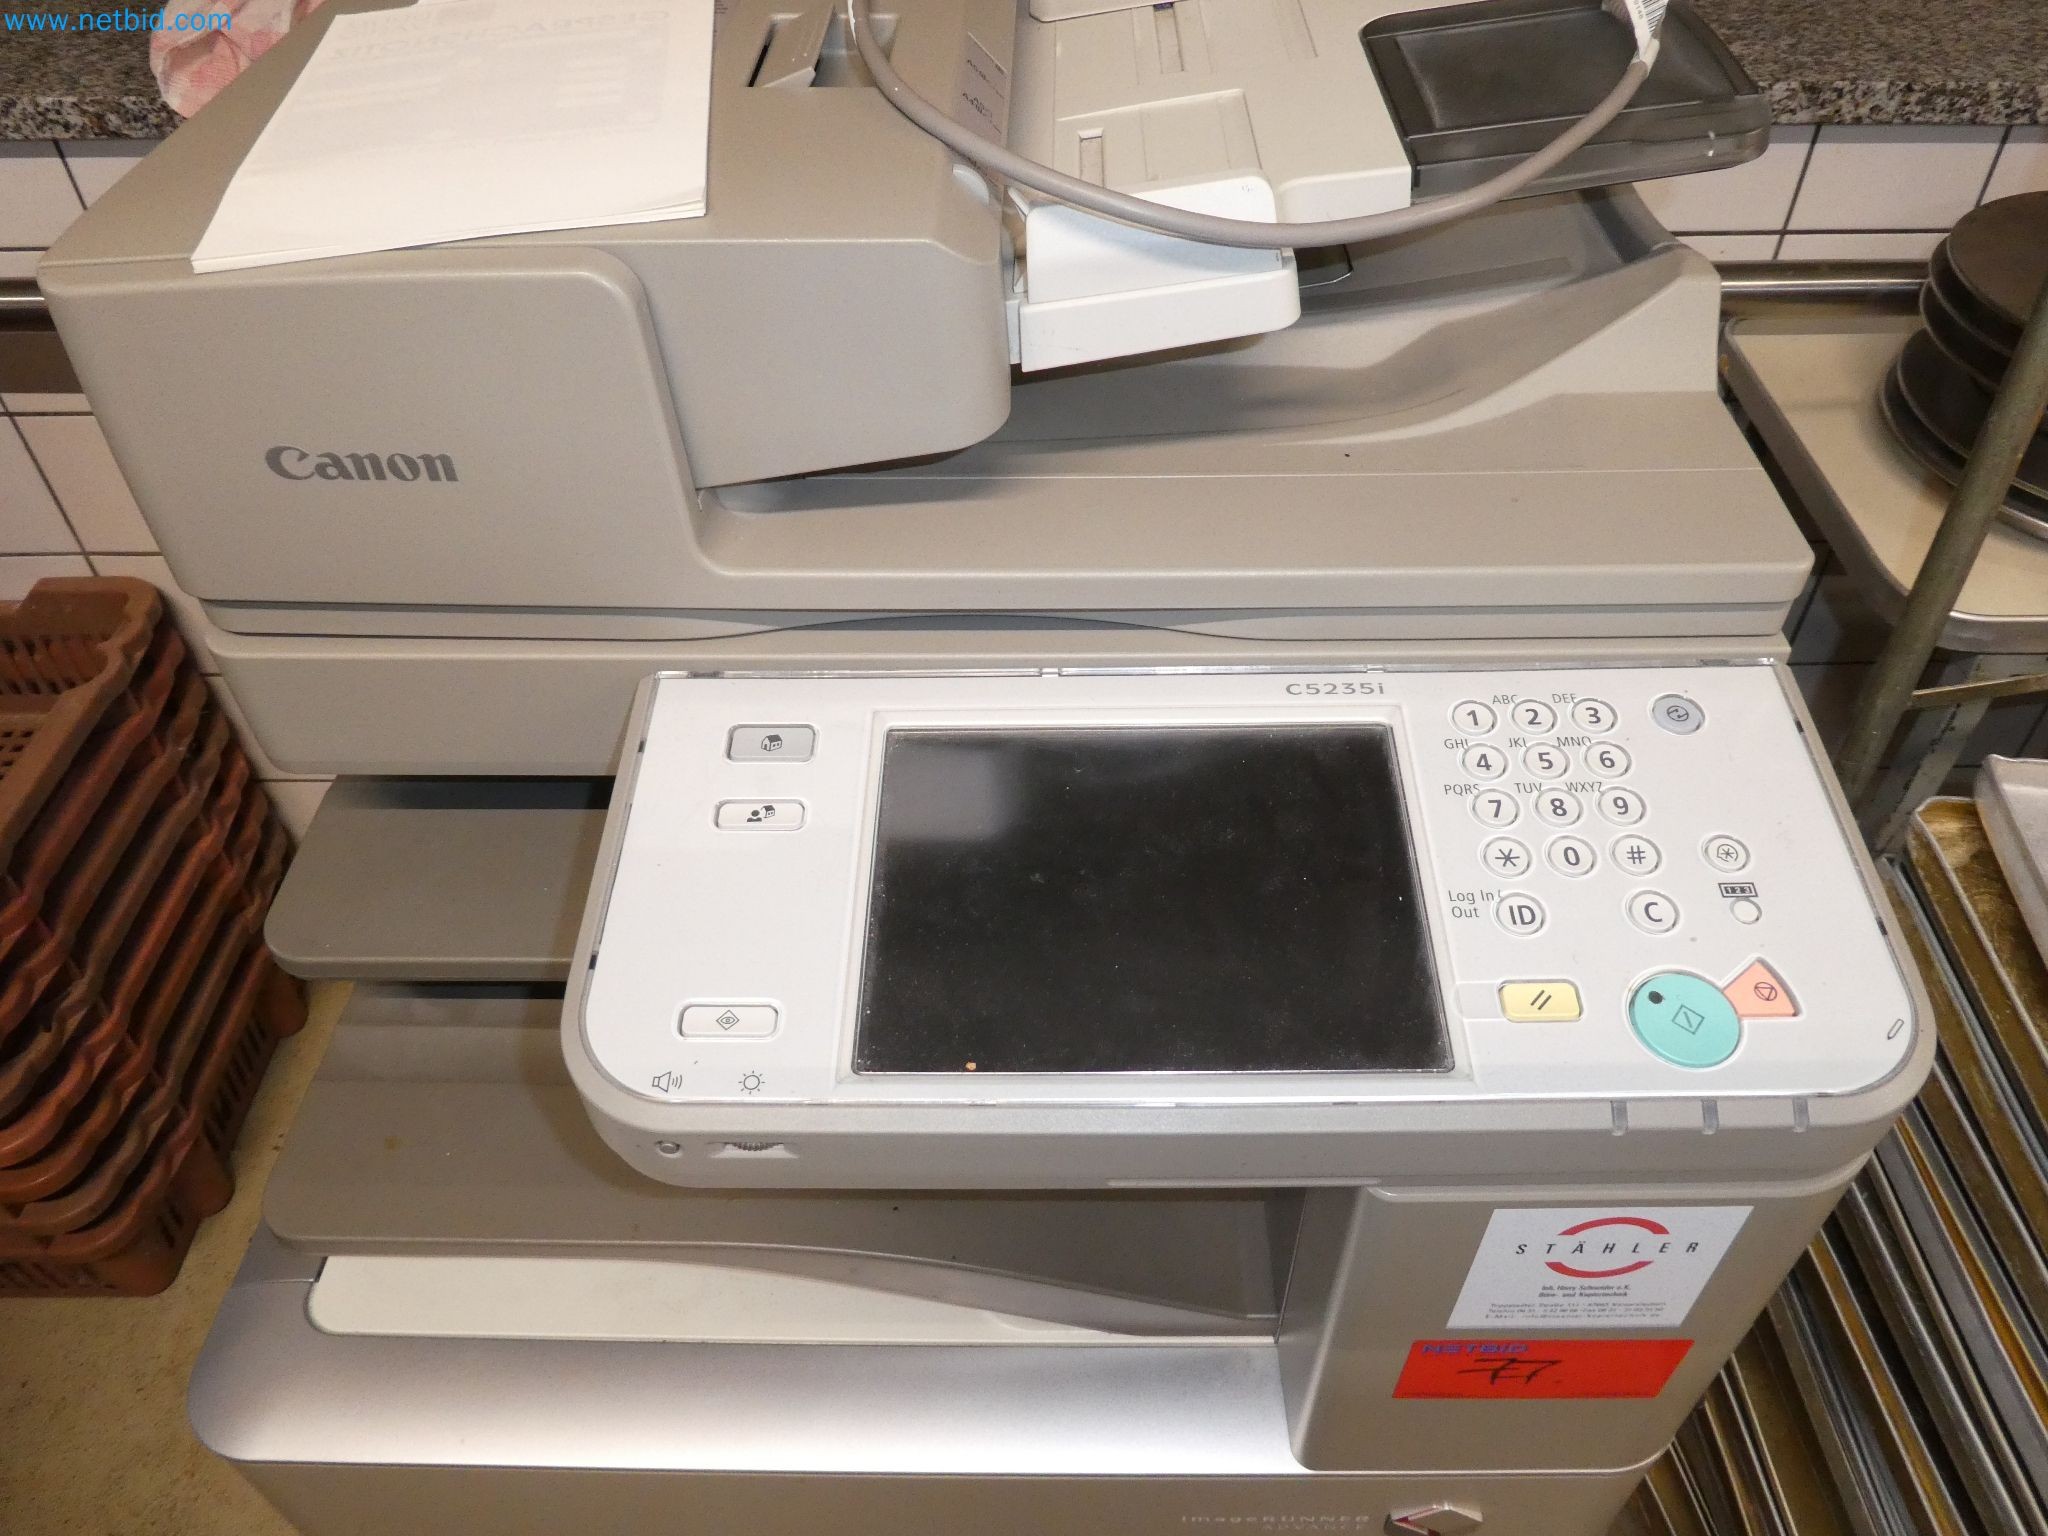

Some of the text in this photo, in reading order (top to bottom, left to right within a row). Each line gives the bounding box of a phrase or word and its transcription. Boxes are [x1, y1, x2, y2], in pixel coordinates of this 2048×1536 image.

[265, 446, 459, 482] Canon
[1285, 682, 1385, 696] C5235i
[1466, 706, 1602, 726] 1 2 3
[1476, 750, 1616, 771] 4 5 6
[1514, 782, 1543, 794] TUV
[1487, 796, 1629, 818] 7 8 9
[1563, 846, 1581, 866] 0
[1448, 890, 1476, 905] Log
[1452, 906, 1480, 918] Out
[1508, 904, 1537, 926] ID
[1643, 901, 1663, 922] C
[1515, 1240, 1700, 1255] STÄHLER
